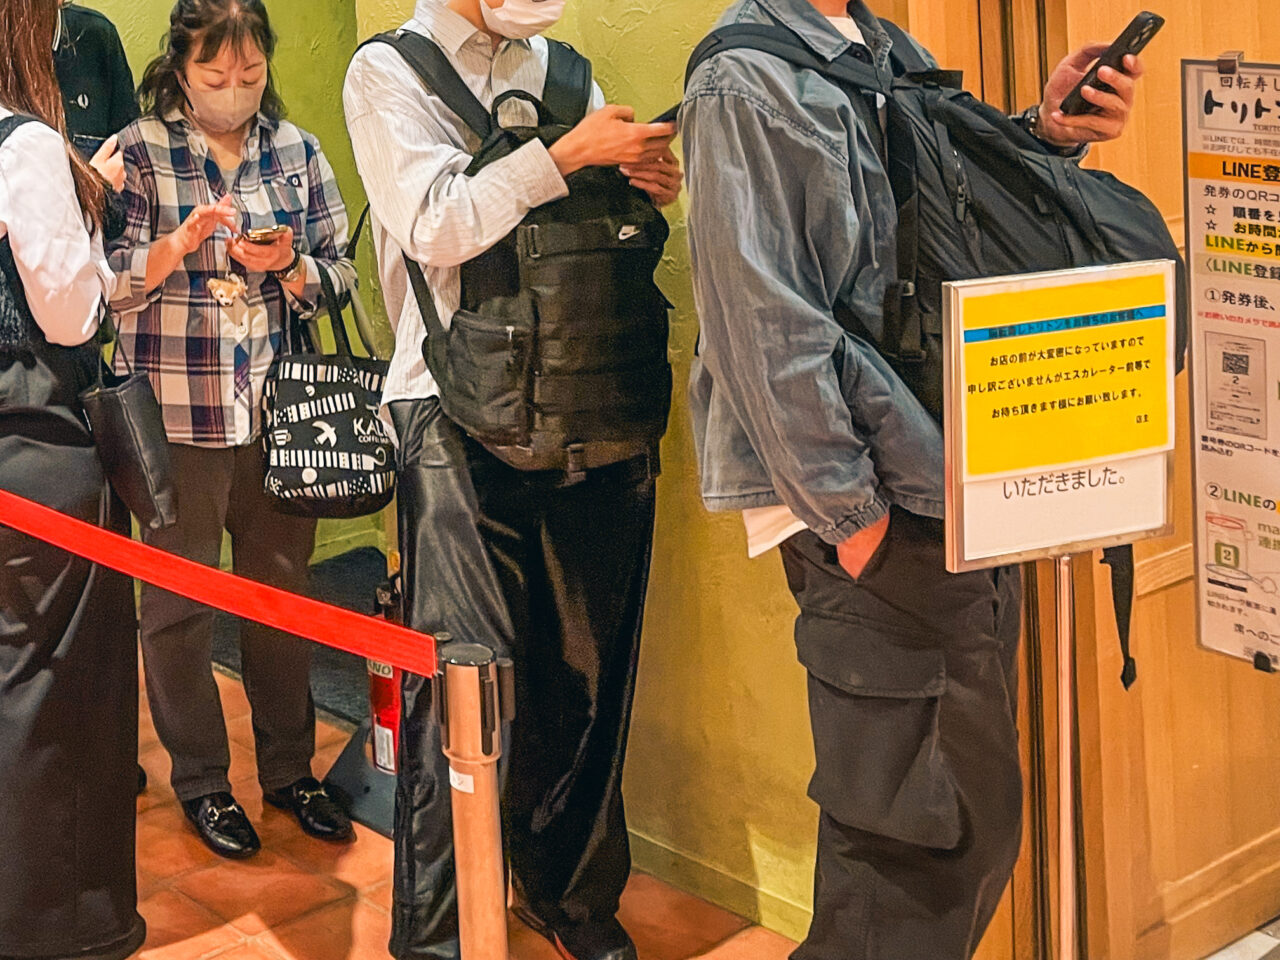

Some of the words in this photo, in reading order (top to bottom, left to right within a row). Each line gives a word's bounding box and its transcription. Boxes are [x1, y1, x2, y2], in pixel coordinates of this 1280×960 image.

[1204, 89, 1280, 124] トリト
[1233, 206, 1280, 223] 順番を
[1234, 222, 1280, 238] お時間
[1003, 466, 1125, 499] いただきました。
